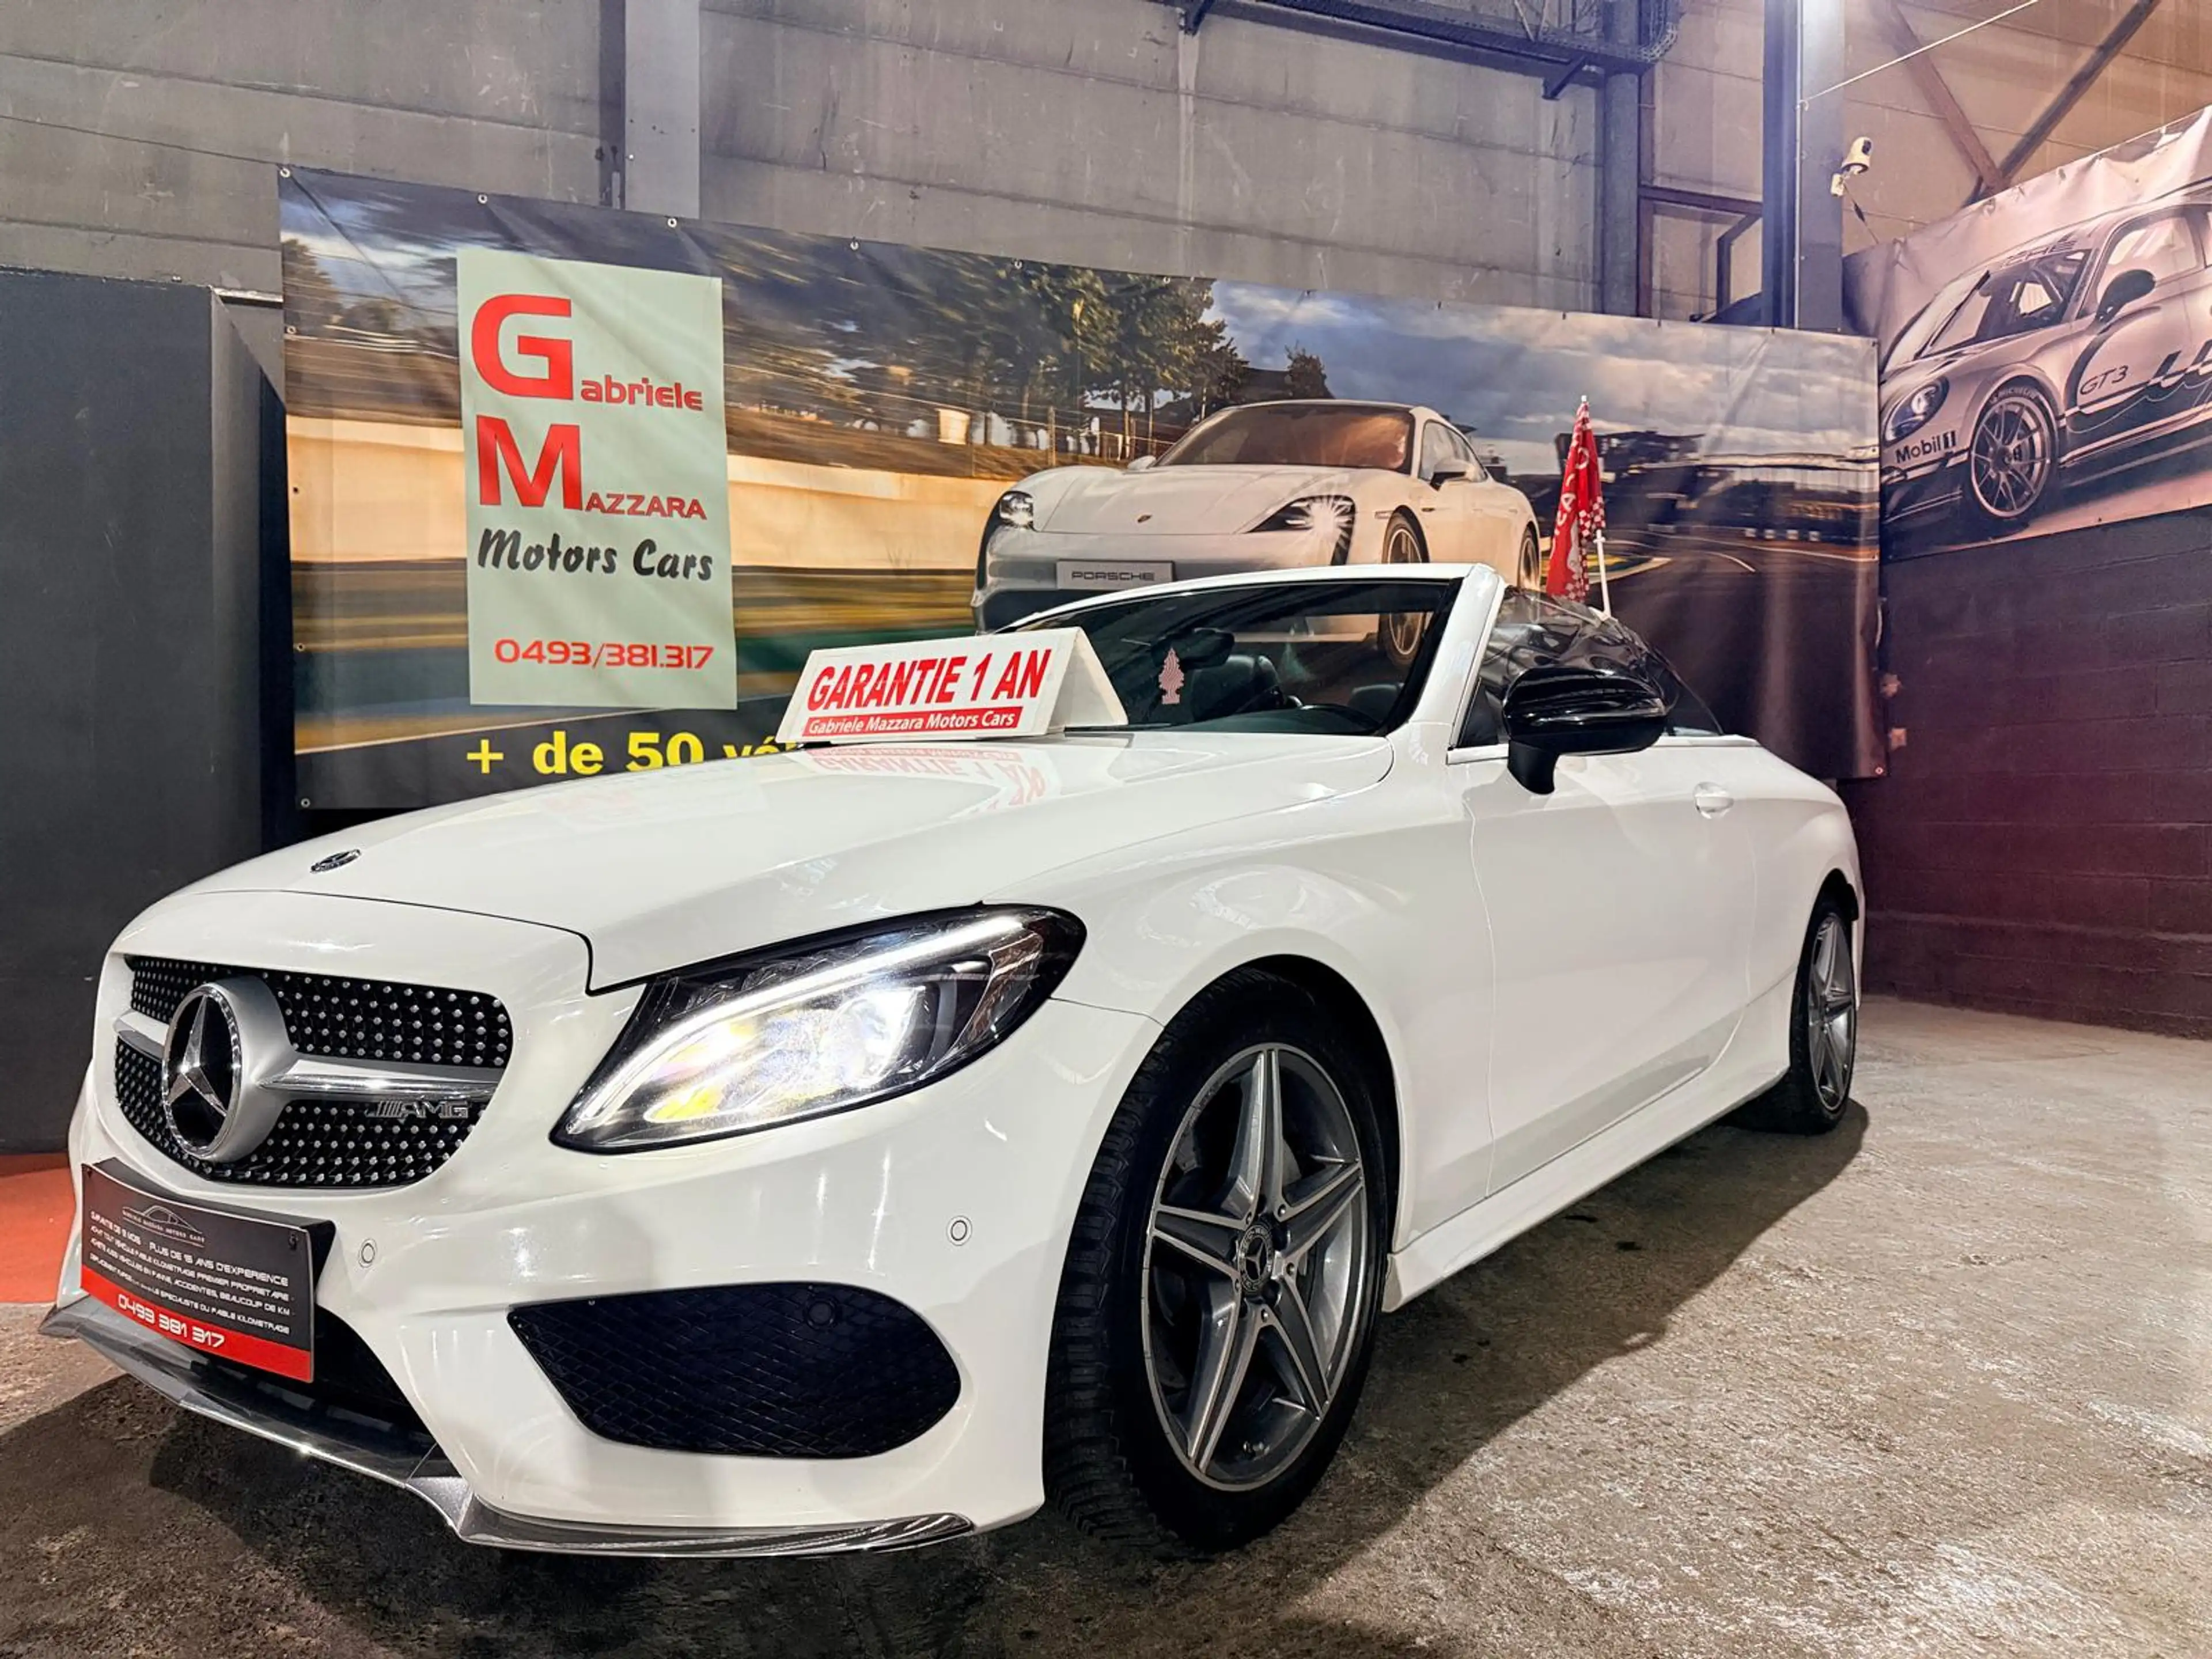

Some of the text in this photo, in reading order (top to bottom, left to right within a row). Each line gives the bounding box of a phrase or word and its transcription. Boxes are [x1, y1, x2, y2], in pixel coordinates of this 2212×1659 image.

[471, 293, 703, 411] Gabriele
[2080, 364, 2130, 395] GT3
[478, 527, 714, 582] Motors Cars
[1071, 571, 1155, 581] PORSCHE
[494, 638, 714, 671] 0493/381.317
[807, 648, 1052, 712] GARANTIE 1 AN
[808, 710, 1016, 735] Gabriele Mazzara Motors Cars
[533, 730, 604, 776] de
[625, 732, 704, 772] 50
[150, 1241, 169, 1256] PLUS
[170, 1249, 182, 1261] DE
[195, 1257, 214, 1270] ANS
[118, 1294, 225, 1348] 0493 381 317
[264, 1303, 276, 1313] DE
[278, 1306, 290, 1316] KM
